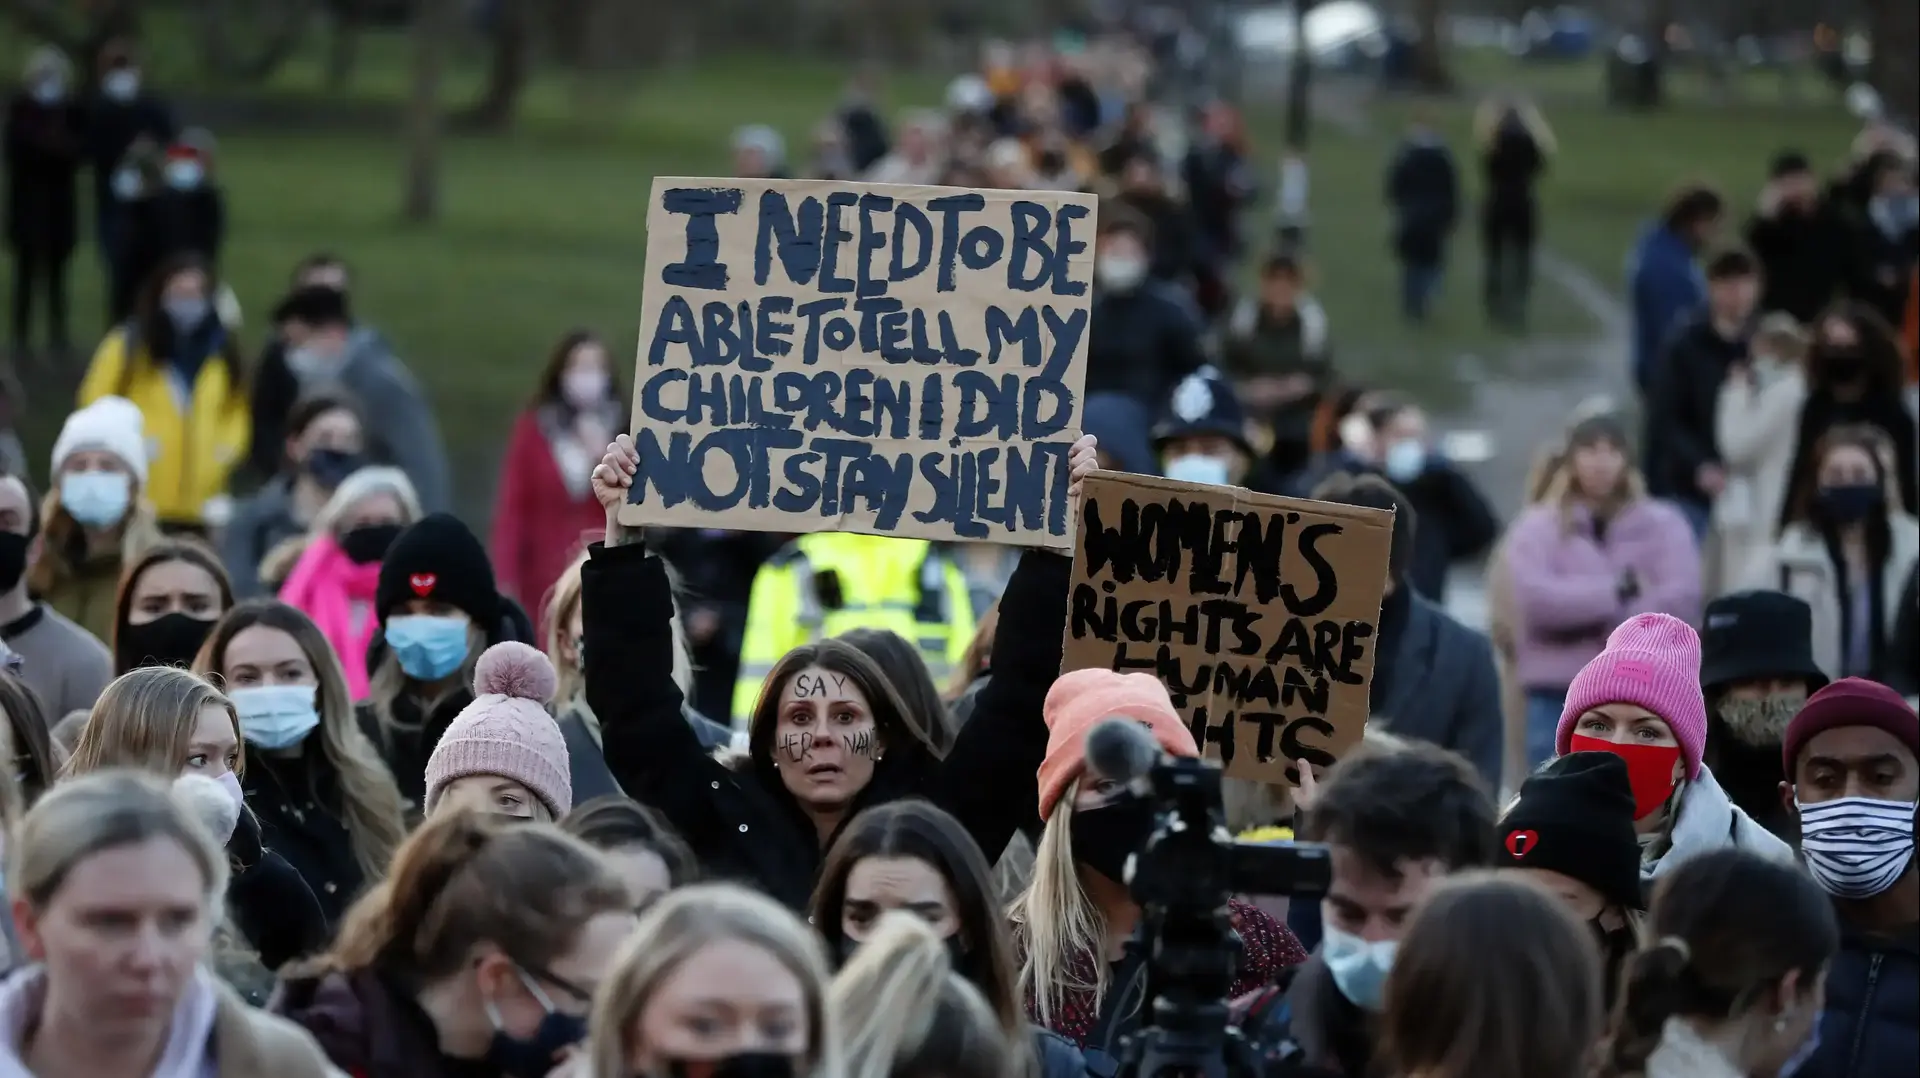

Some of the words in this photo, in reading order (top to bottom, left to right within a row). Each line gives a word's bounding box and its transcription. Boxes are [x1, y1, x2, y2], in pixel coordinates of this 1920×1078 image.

[662, 187, 744, 290] I
[754, 189, 934, 299] NEED
[1007, 200, 1091, 296] BE
[648, 295, 795, 372] ABLE
[854, 297, 982, 366] TELL
[984, 304, 1088, 382] MY
[641, 368, 911, 439] CHILDREN
[918, 372, 944, 440] I
[951, 370, 1077, 441] DID
[626, 427, 803, 511] NOT
[772, 438, 914, 531] STAY
[794, 674, 846, 698] SAY
[1265, 618, 1373, 685] ARE
[779, 731, 813, 763] HER
